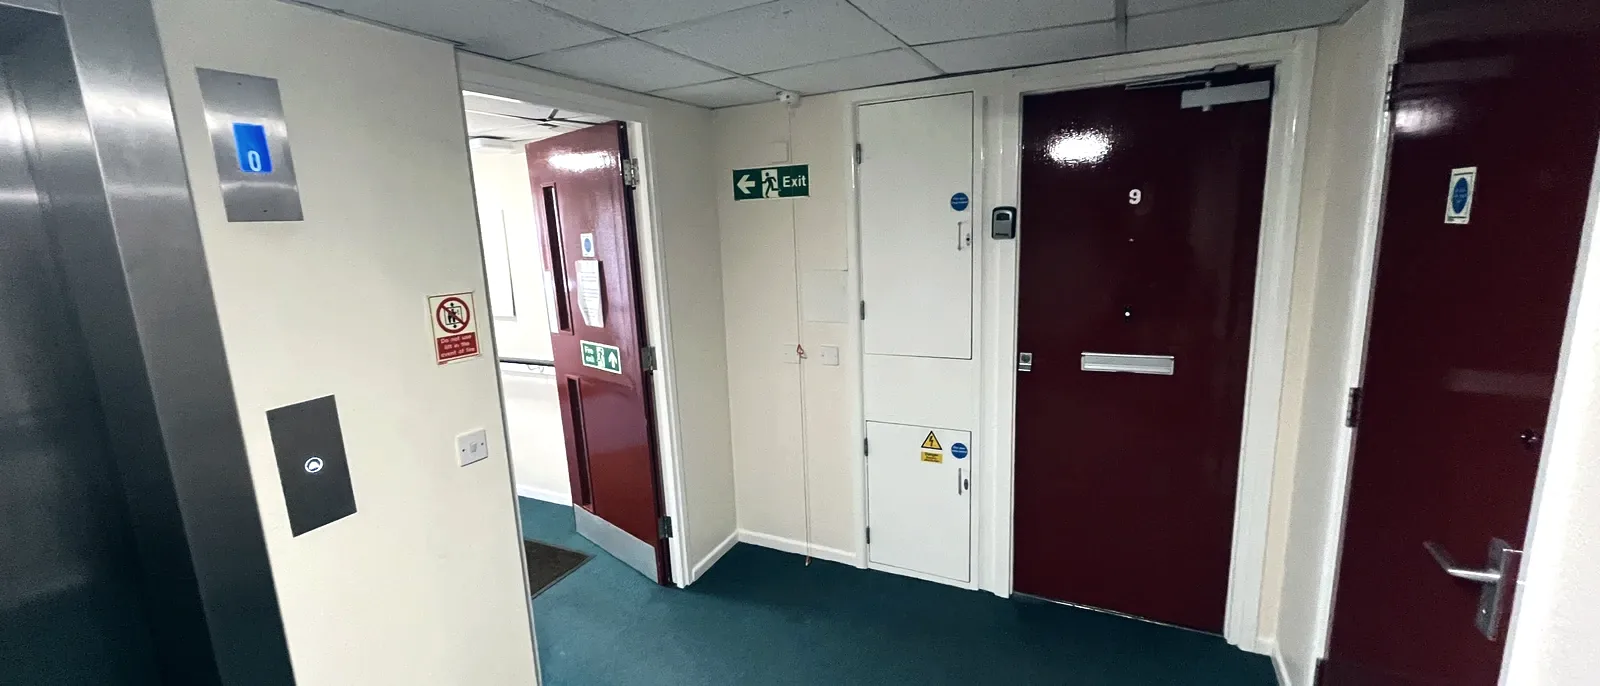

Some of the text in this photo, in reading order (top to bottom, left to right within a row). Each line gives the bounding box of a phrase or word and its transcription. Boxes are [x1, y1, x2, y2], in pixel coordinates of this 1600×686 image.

[247, 149, 262, 172] 0
[782, 175, 807, 188] Exit
[1128, 188, 1142, 205] 9
